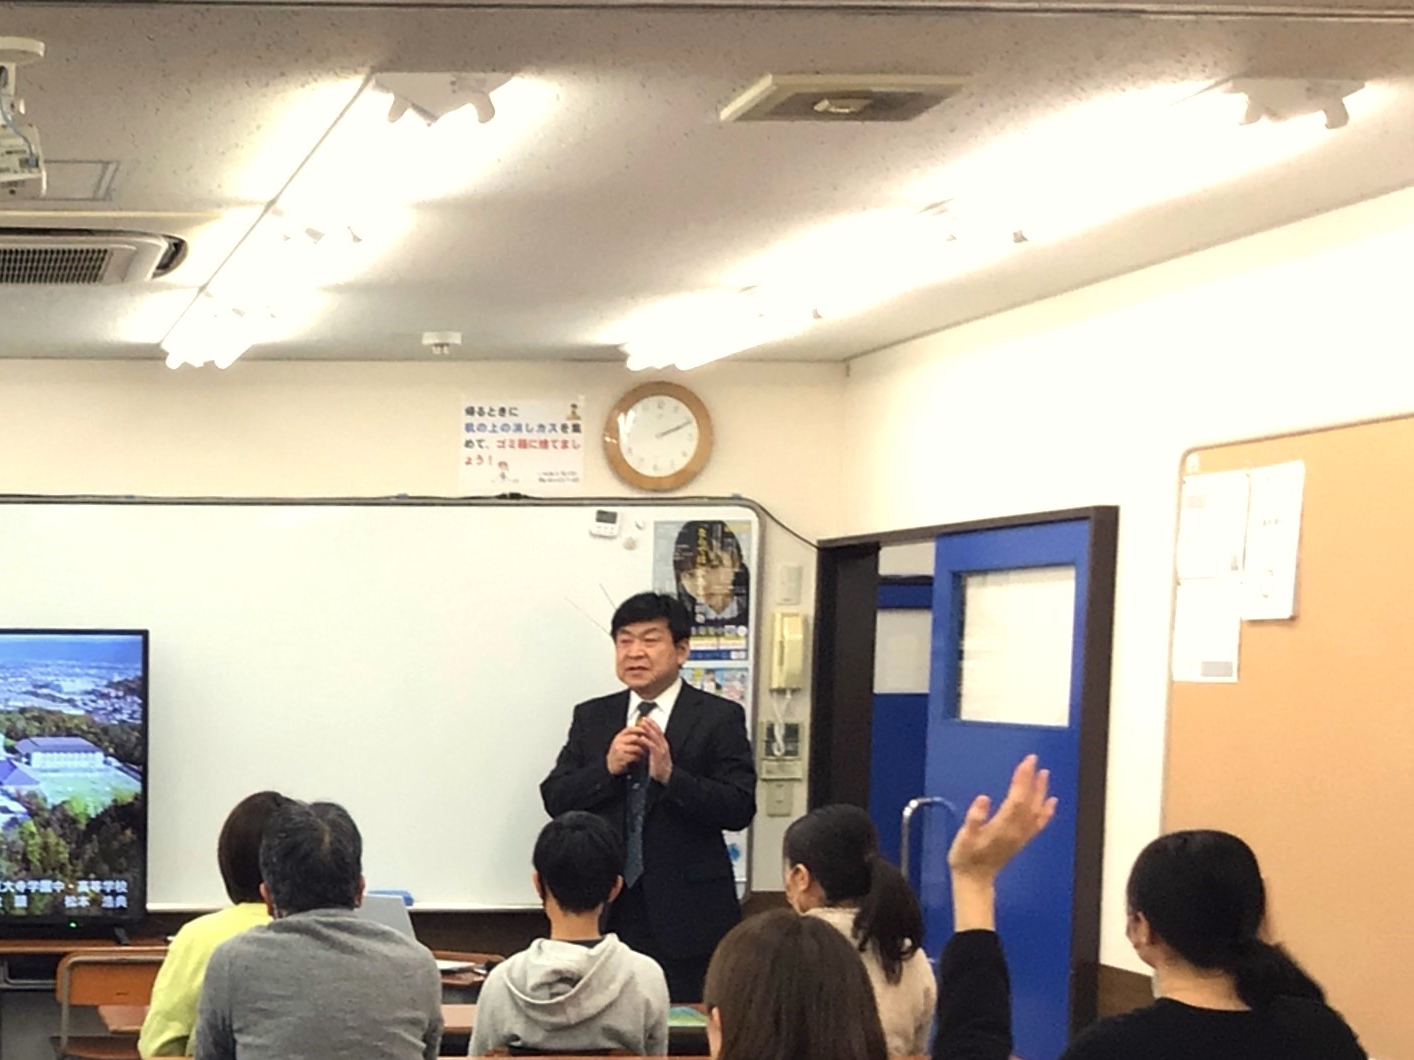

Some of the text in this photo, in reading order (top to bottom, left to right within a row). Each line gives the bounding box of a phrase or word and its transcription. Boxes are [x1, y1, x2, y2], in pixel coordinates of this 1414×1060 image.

[464, 405, 519, 418] 帰るときに
